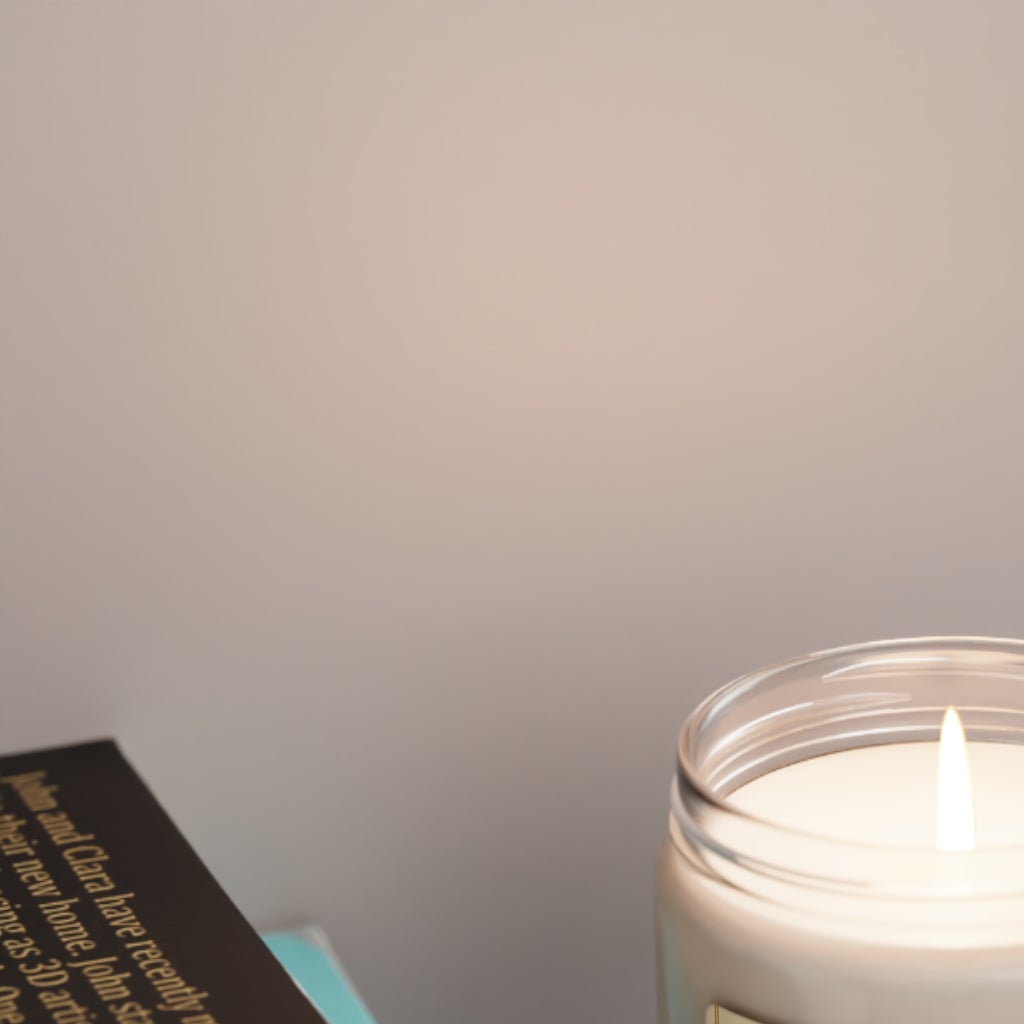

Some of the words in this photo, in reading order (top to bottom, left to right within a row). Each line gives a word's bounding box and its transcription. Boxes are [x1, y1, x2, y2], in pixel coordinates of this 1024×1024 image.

[36, 811, 96, 846] and
[12, 859, 62, 897] new
[62, 845, 116, 893] Clara
[38, 897, 97, 958] home.
[94, 892, 148, 938] have
[2, 936, 42, 960] as
[17, 958, 70, 988] 3D
[65, 956, 132, 1002] John
[124, 938, 209, 1012] recently
